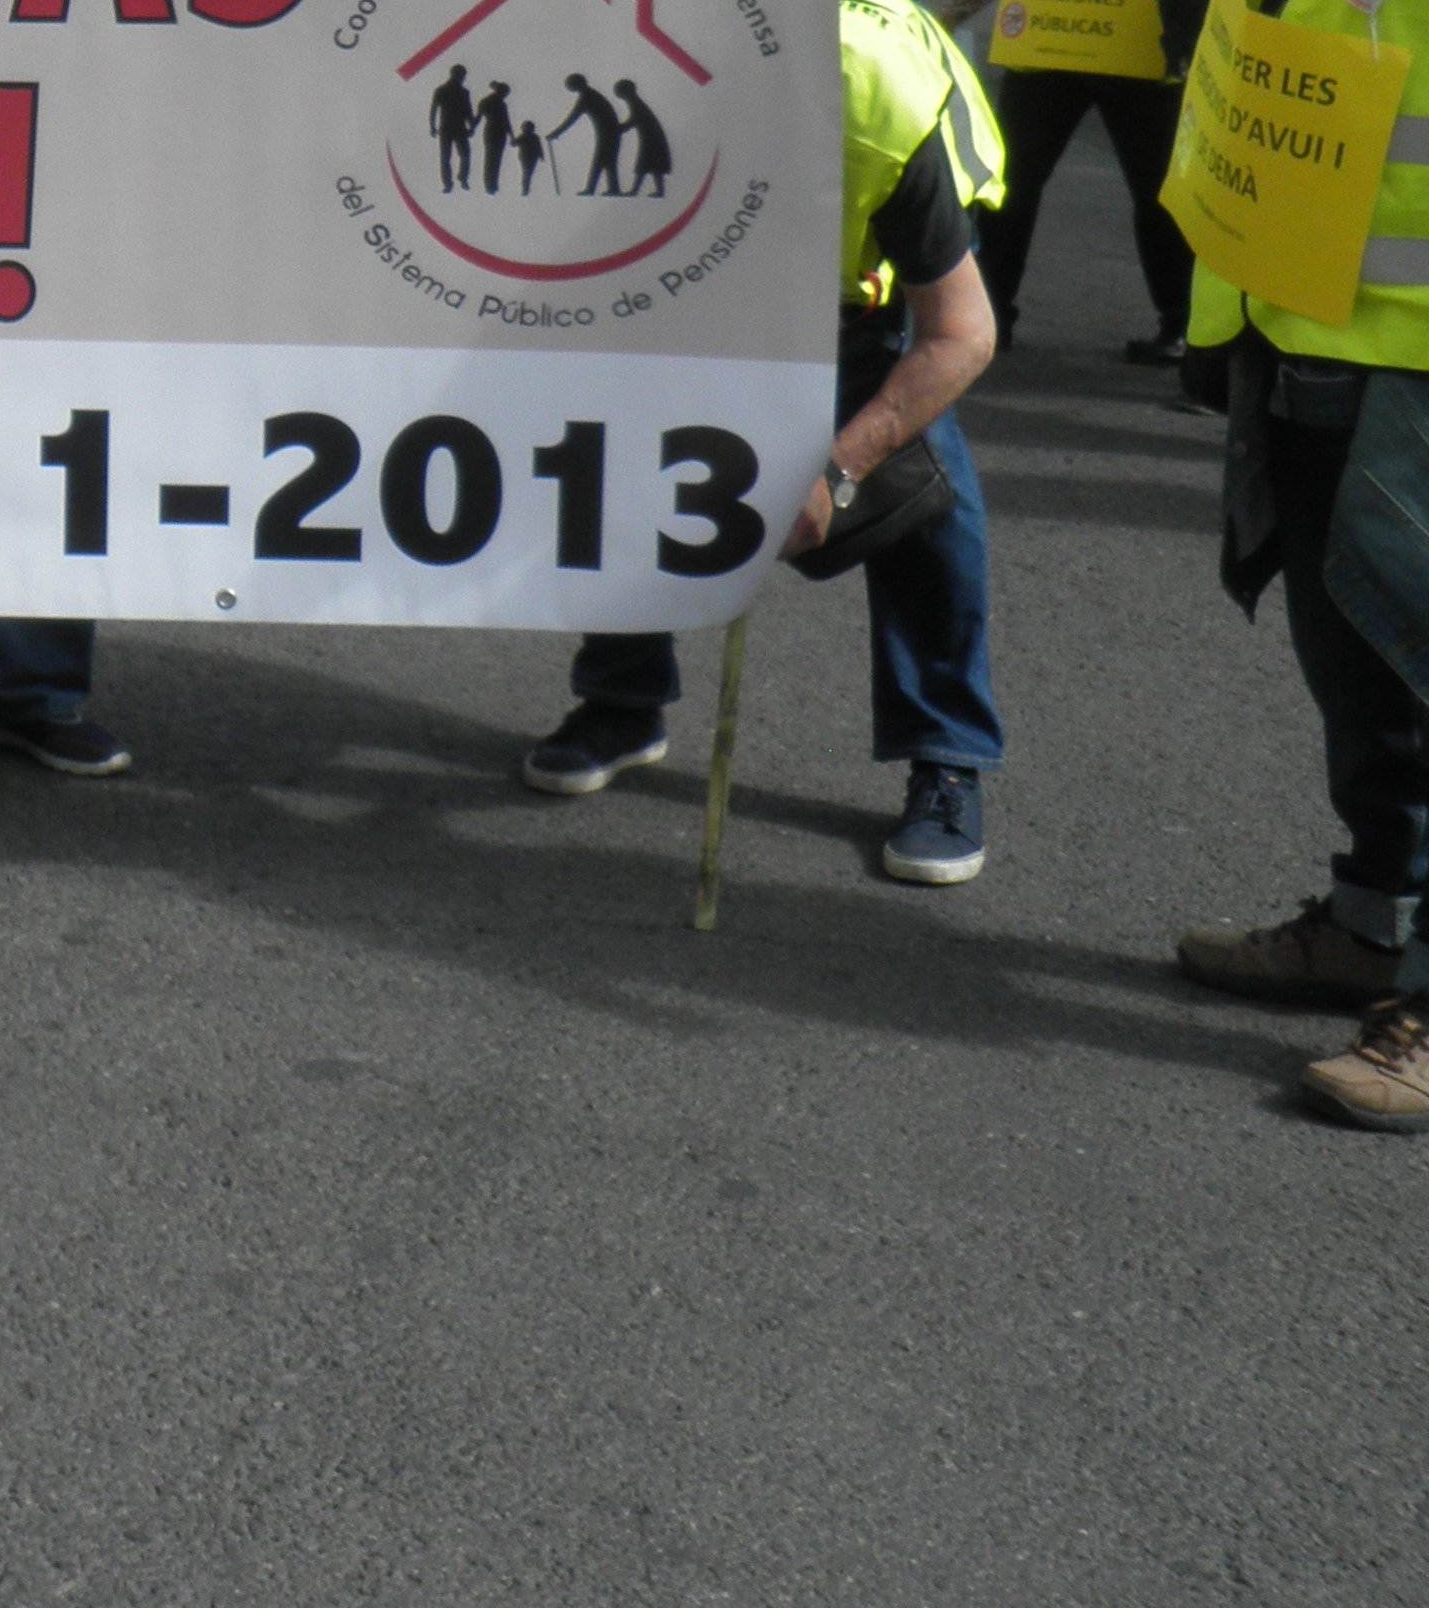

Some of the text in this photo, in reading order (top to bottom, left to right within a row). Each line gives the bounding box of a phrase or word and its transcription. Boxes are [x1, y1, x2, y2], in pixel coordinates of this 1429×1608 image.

[1281, 67, 1338, 107] LES
[1228, 105, 1324, 164] D'AVUI
[1333, 140, 1346, 170] I
[335, 174, 771, 328] del Sistema Público de Pensiones
